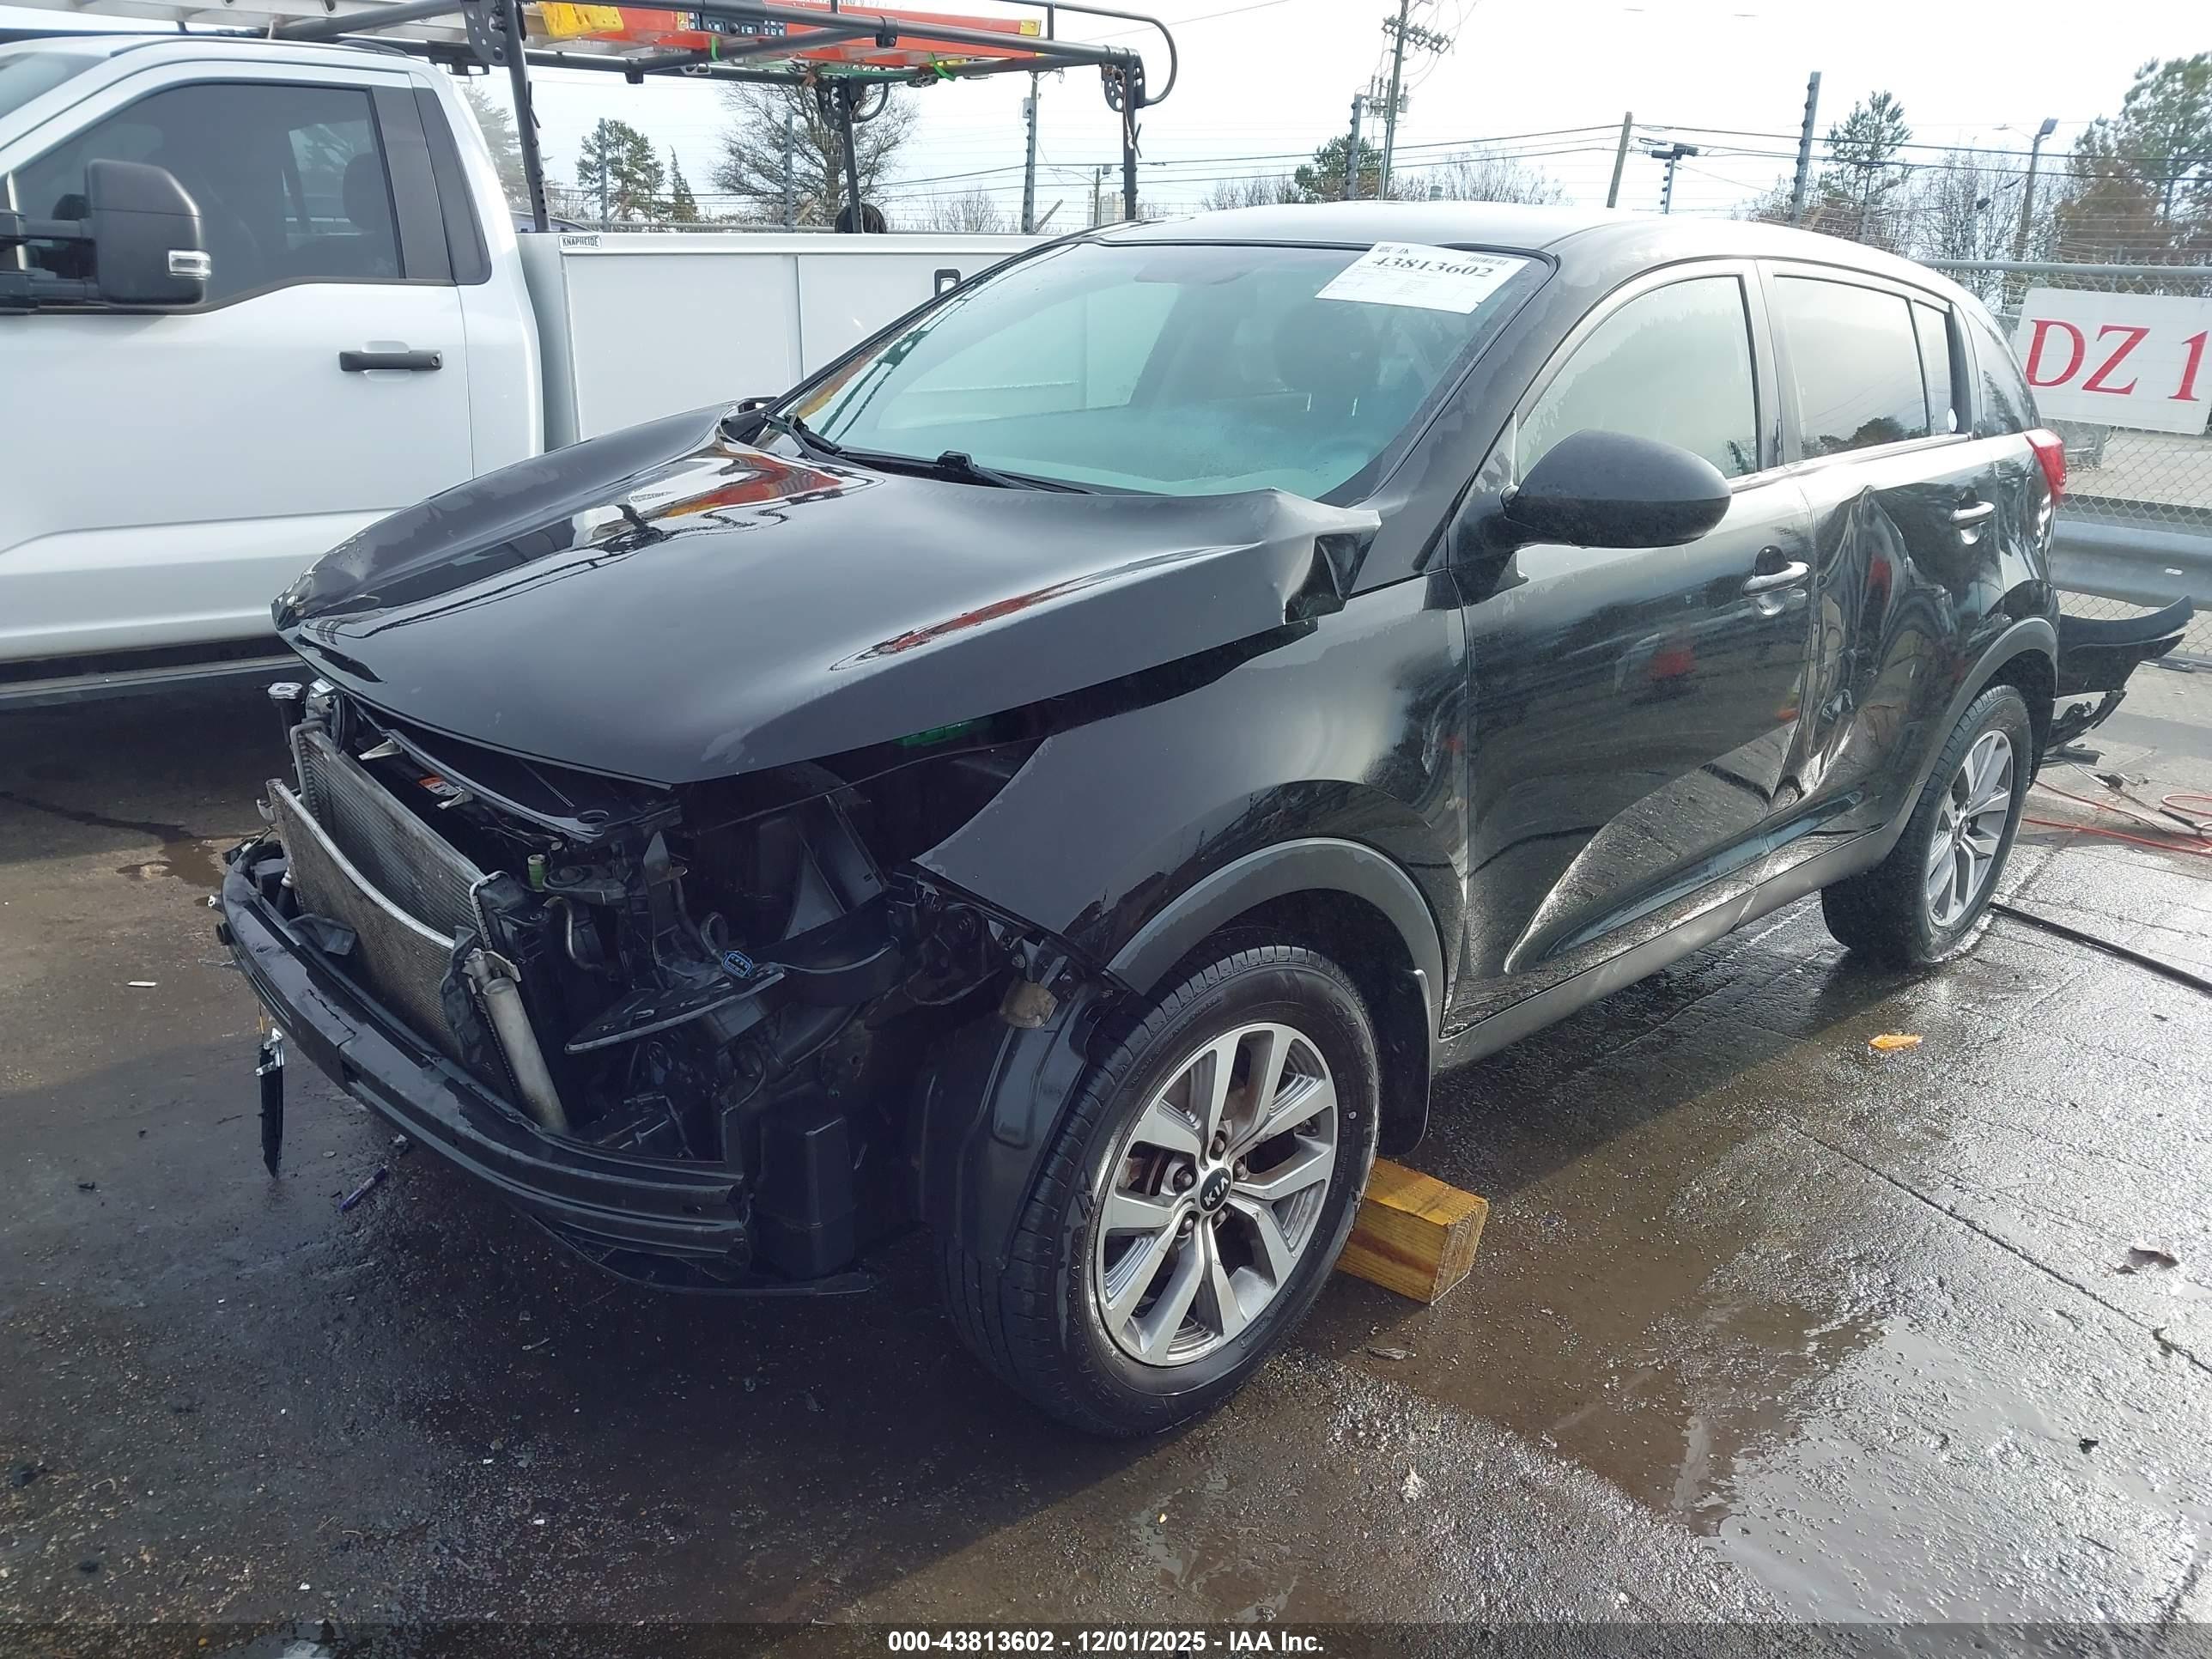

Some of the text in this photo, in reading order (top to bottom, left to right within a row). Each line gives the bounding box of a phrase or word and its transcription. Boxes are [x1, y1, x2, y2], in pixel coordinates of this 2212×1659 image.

[1371, 256, 1494, 278] 43813602
[2025, 319, 2209, 402] DZ 1
[1203, 1176, 1230, 1207] KIA
